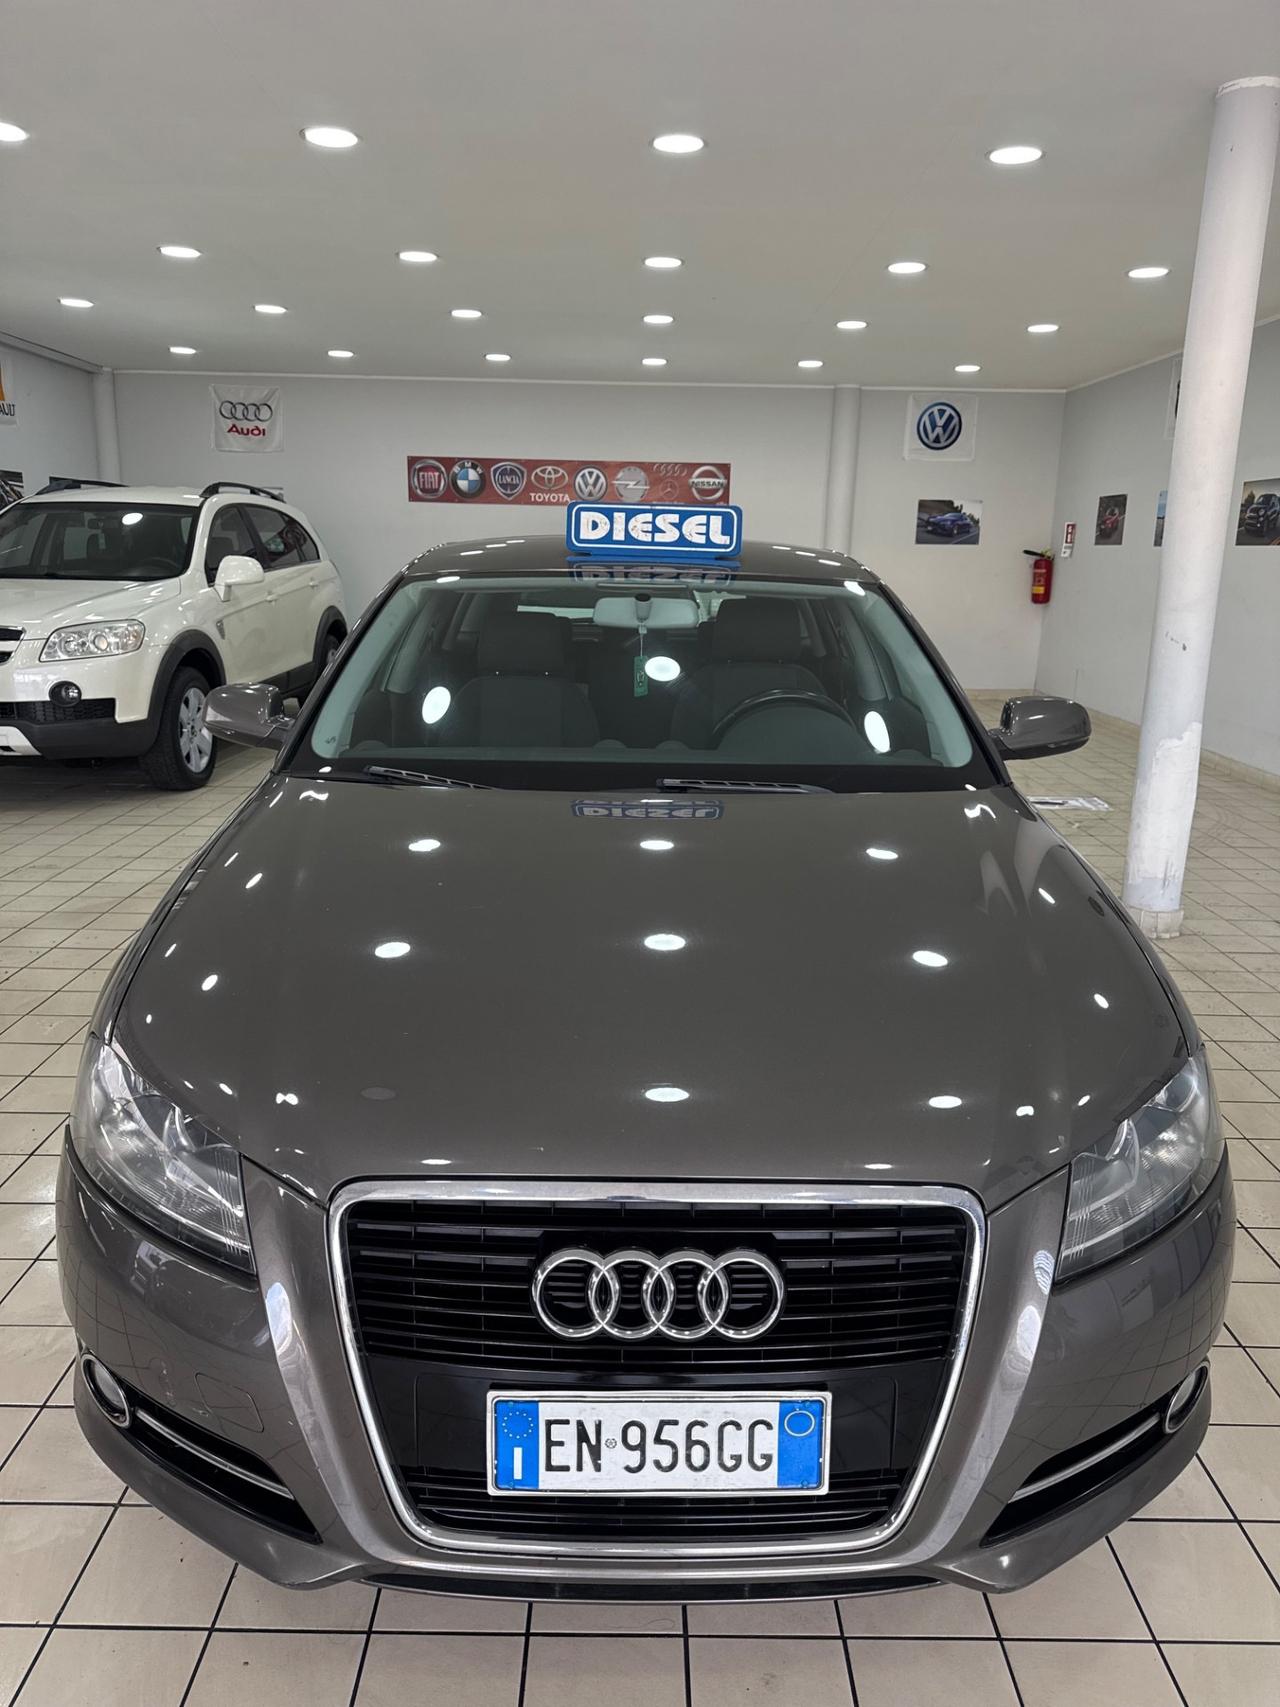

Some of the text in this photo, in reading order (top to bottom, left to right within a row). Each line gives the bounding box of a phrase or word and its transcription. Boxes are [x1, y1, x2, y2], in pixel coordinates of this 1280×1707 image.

[227, 423, 266, 437] Audi
[453, 461, 484, 474] BMW
[419, 472, 439, 489] FIAT
[499, 475, 520, 485] LANCIA
[691, 480, 724, 488] NISSAN
[529, 492, 571, 503] TOYOTA
[580, 511, 731, 545] DIESEL
[544, 1419, 774, 1474] EN 956GG
[513, 1447, 522, 1480] I
